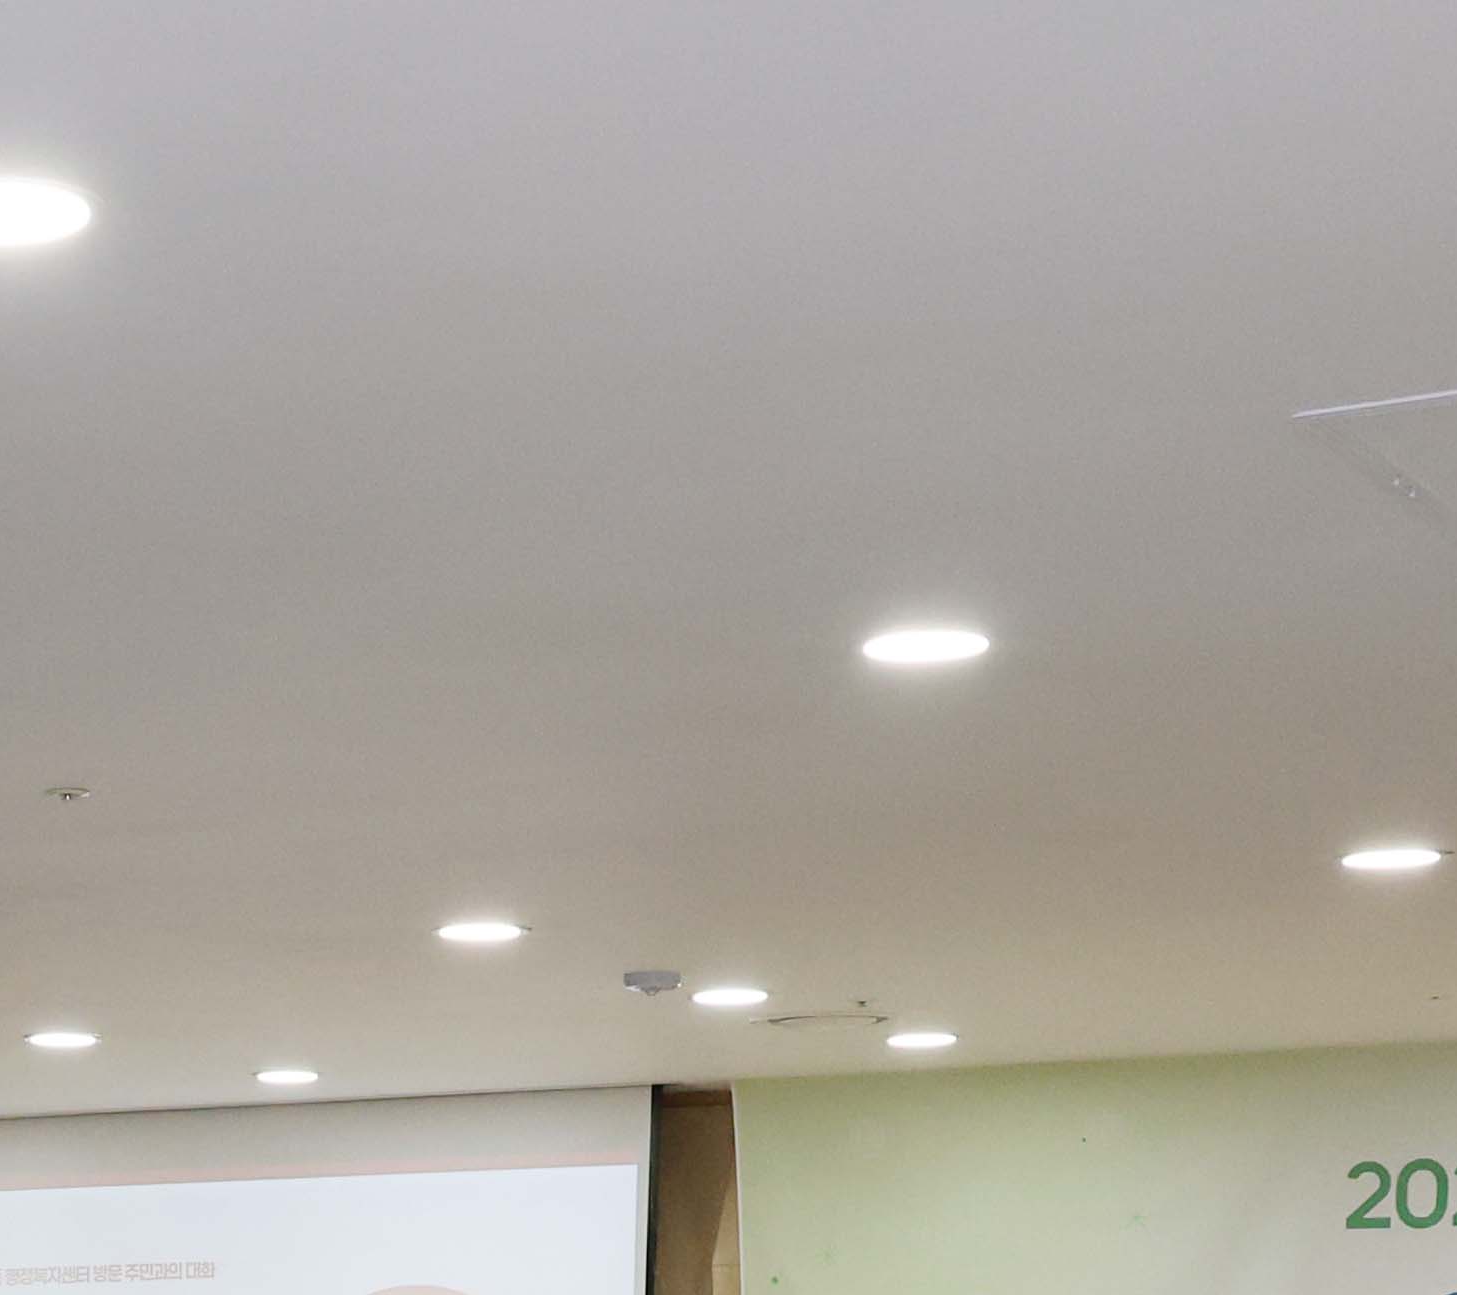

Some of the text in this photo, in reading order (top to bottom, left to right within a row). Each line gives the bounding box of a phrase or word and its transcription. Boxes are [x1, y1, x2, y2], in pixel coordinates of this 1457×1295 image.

[93, 1264, 125, 1283] 방문
[125, 1262, 184, 1282] 주민과의
[186, 1261, 216, 1280] 대화
